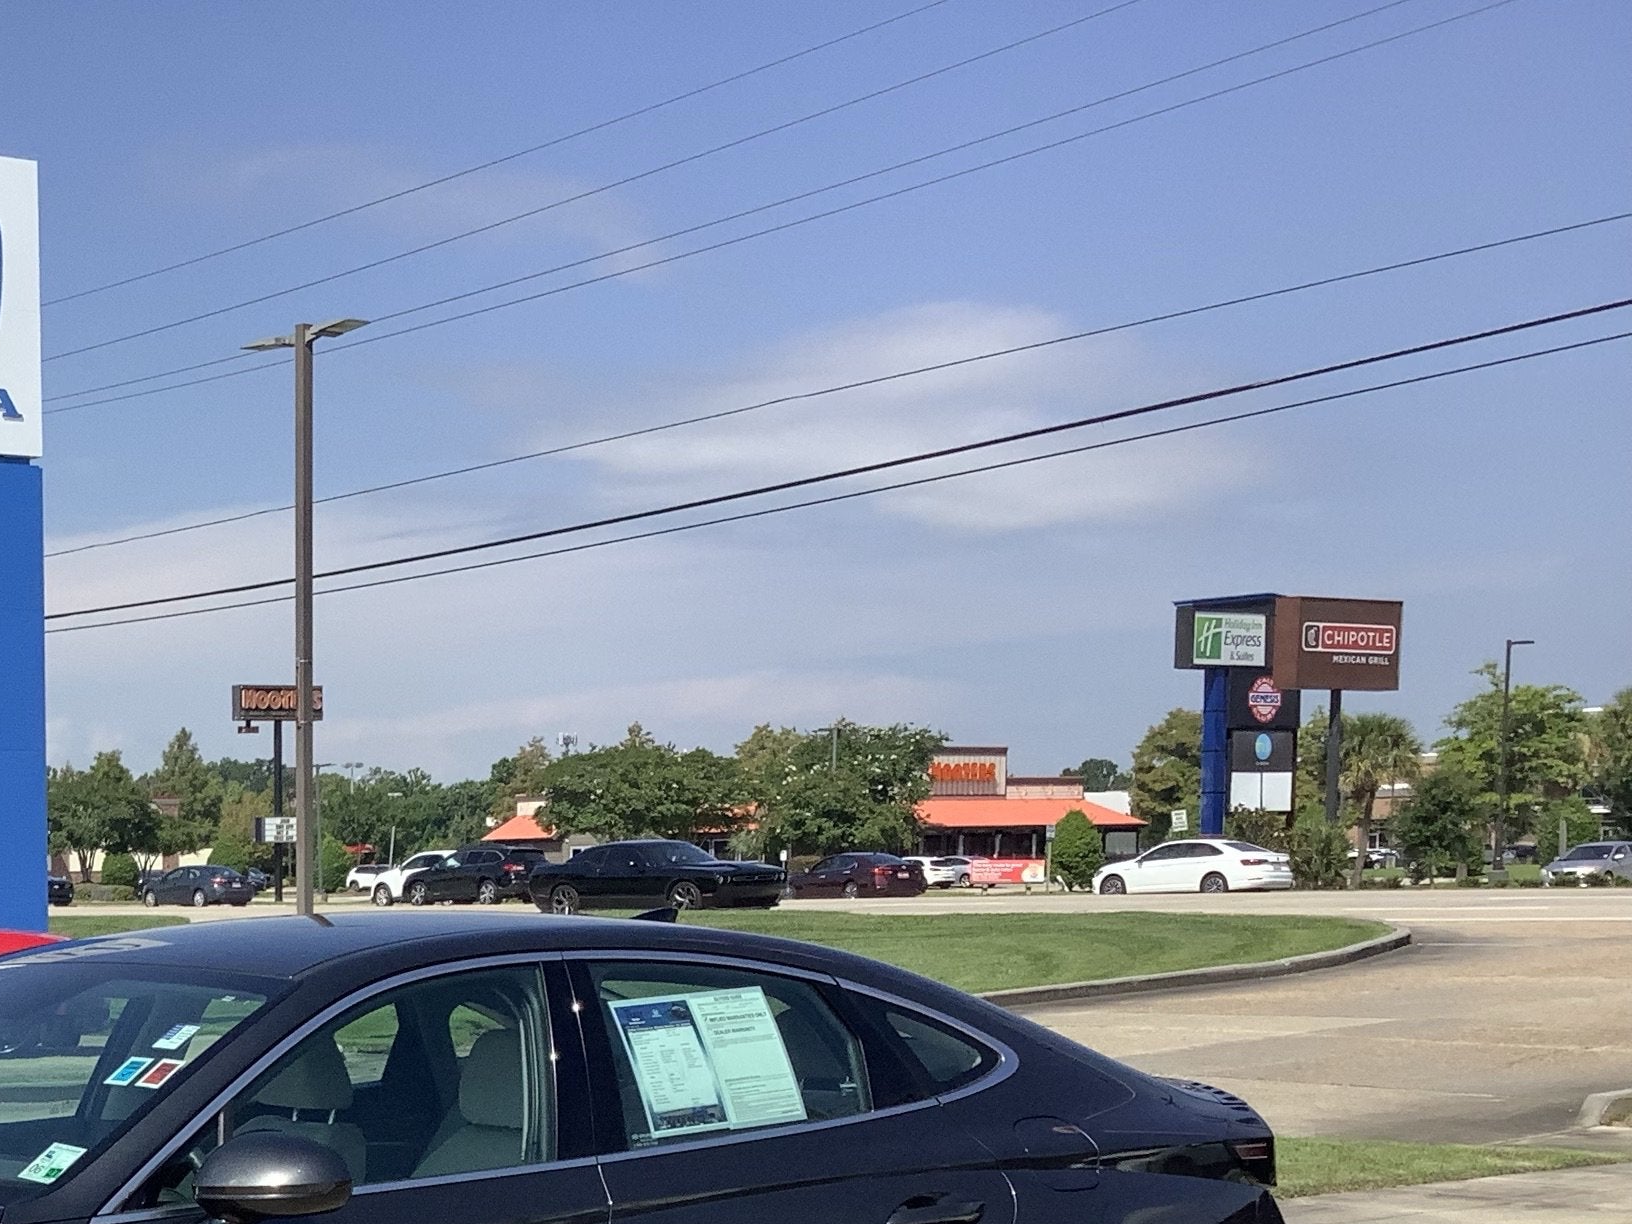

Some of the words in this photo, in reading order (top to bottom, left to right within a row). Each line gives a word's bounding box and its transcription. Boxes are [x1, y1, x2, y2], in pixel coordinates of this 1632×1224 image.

[1224, 630, 1262, 650] Express
[1324, 630, 1391, 647] CHIPOTLE
[1332, 655, 1366, 664] MEXICAN
[1368, 656, 1390, 665] GRILL
[241, 688, 323, 710] HOOTS
[931, 762, 996, 781] HOOTERS
